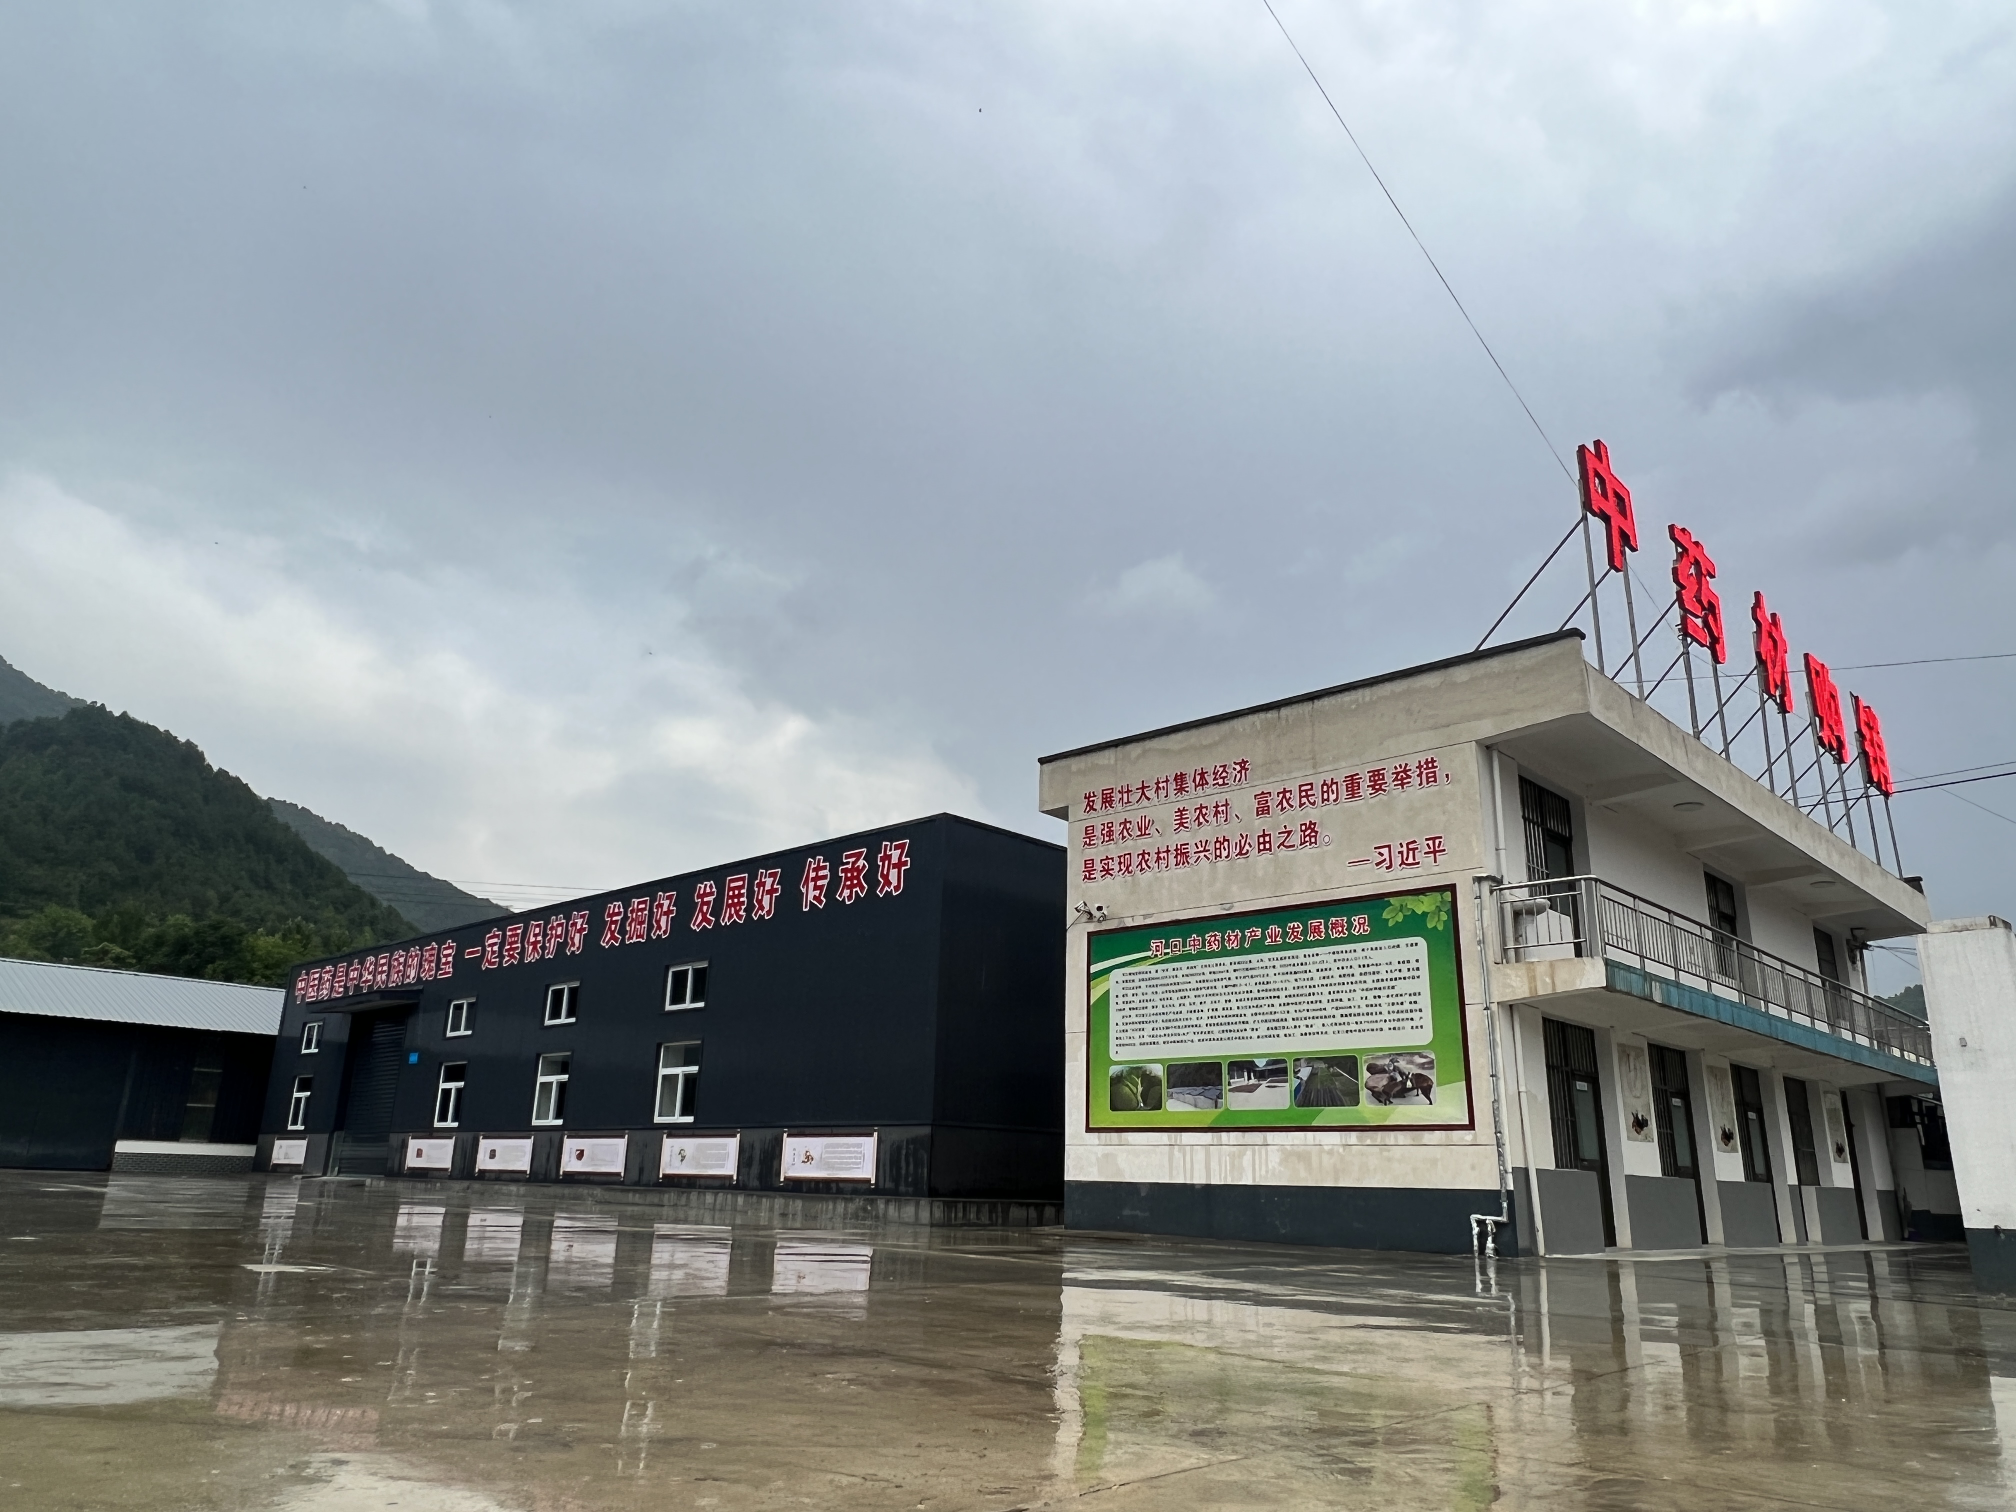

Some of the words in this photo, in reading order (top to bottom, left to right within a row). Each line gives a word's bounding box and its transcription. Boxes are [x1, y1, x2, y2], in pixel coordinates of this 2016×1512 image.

[1082, 756, 1452, 849] 是强农业、美农村、富农民的重要举措，
[1083, 758, 1251, 815] 发展壮大村集体经济
[1082, 819, 1332, 882] 是实现农村振兴的必由之路。
[295, 939, 457, 1004] 中医药是中华民族的瑰宝
[465, 911, 589, 970] 一定要保护好
[600, 891, 676, 948] 发掘好
[691, 868, 781, 931] 发展好
[800, 839, 911, 911] 传承好
[1149, 914, 1371, 958] 河口中药材产业发展概况
